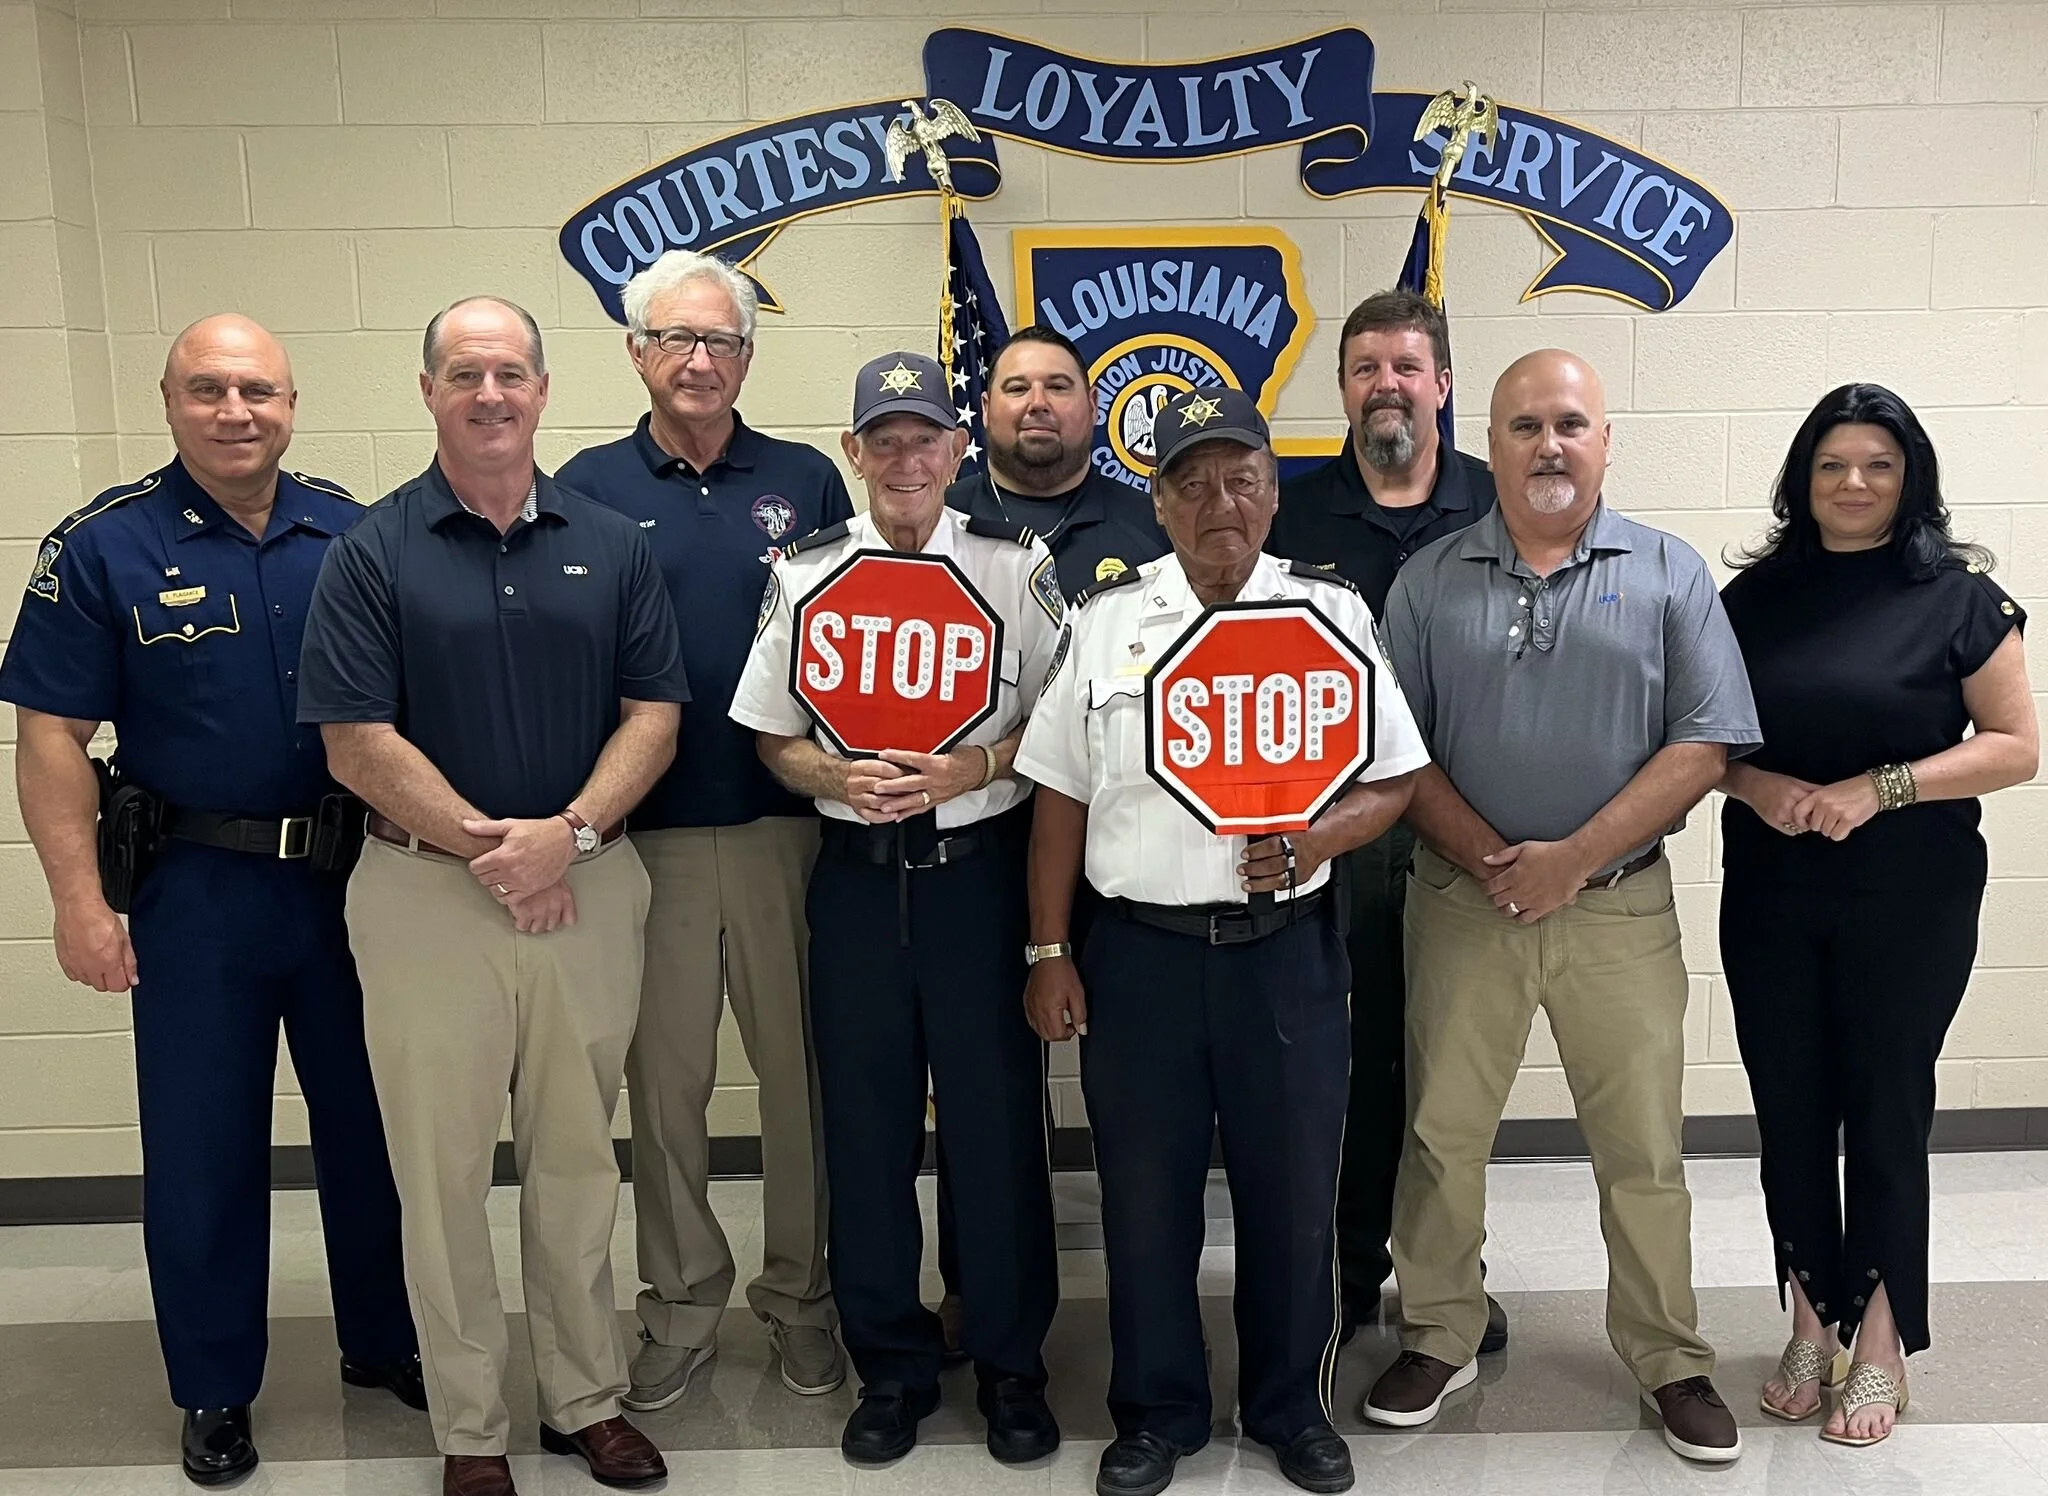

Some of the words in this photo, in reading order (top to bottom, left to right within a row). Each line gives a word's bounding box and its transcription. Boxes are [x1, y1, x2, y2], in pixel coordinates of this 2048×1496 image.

[972, 46, 1322, 148] LOYALTY
[580, 112, 914, 285] COURTESY
[1408, 117, 1712, 267] SERVICE
[1040, 259, 1282, 349] LOUISIANA
[805, 610, 986, 702] STOP
[1166, 669, 1353, 769] STOP
